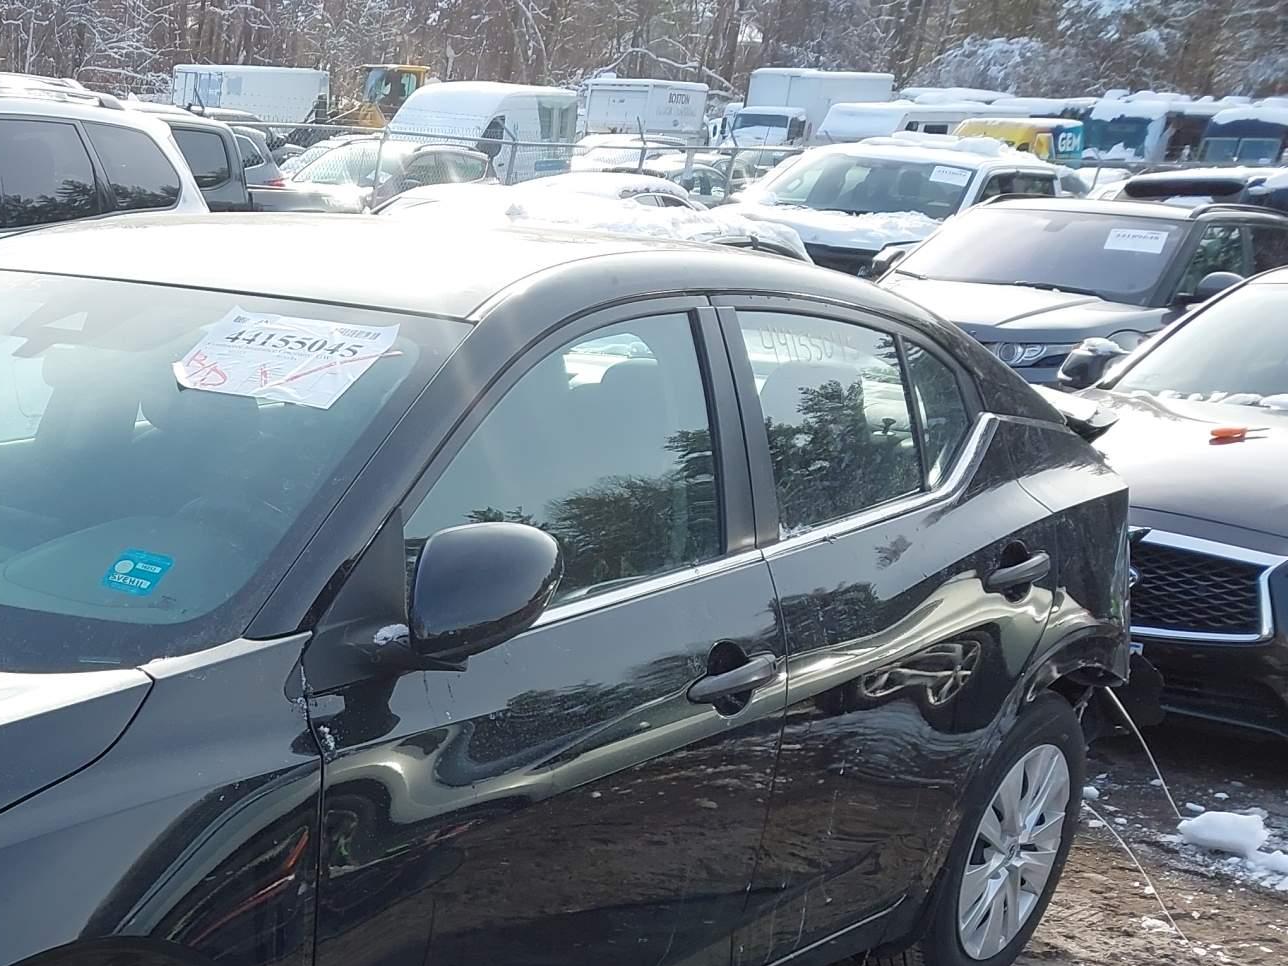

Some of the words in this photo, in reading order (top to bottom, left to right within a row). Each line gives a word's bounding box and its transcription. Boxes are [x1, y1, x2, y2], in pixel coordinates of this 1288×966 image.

[668, 92, 691, 104] BOSTON
[1057, 131, 1082, 152] GEM
[225, 329, 364, 357] 44155045
